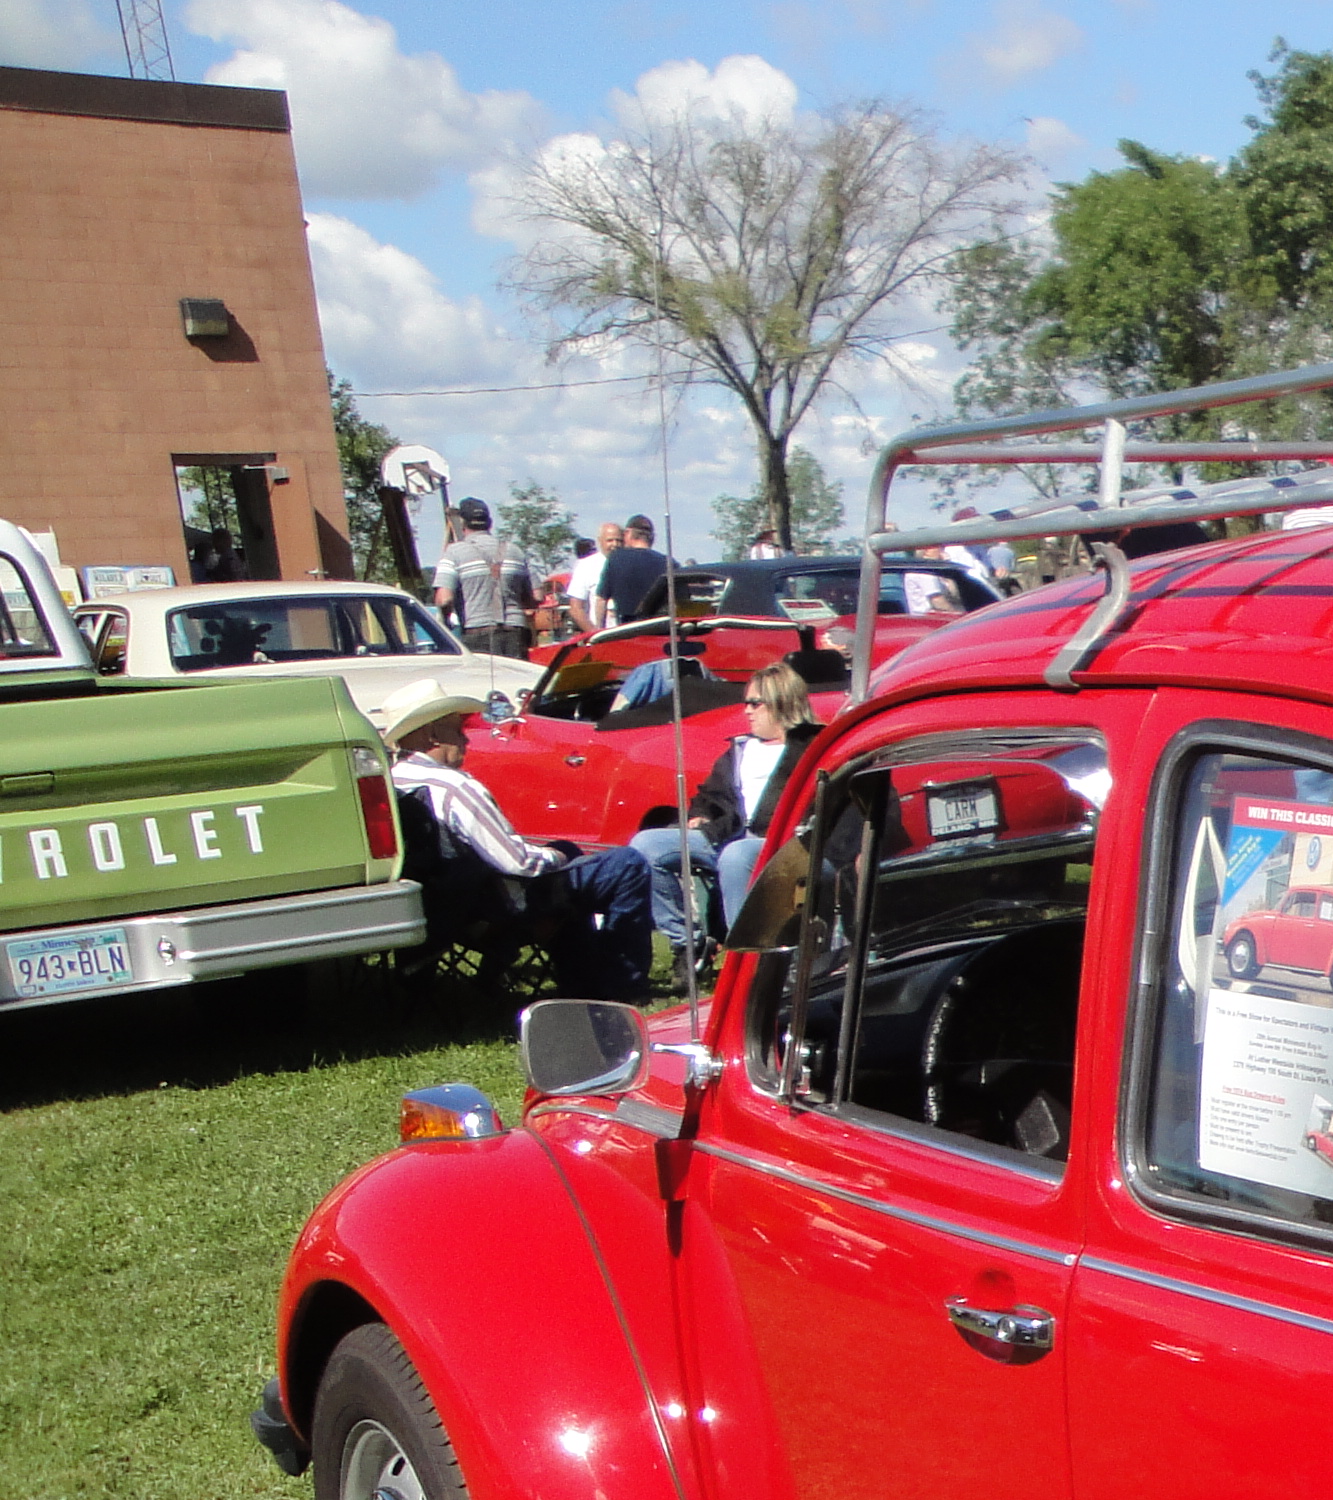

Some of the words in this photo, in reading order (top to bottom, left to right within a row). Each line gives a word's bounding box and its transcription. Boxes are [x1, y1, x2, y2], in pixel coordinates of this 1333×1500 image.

[1248, 806, 1268, 819] WIN
[1270, 808, 1294, 822] THIS
[0, 805, 264, 882] ROLET
[19, 954, 65, 983] 943
[77, 946, 126, 975] BLN
